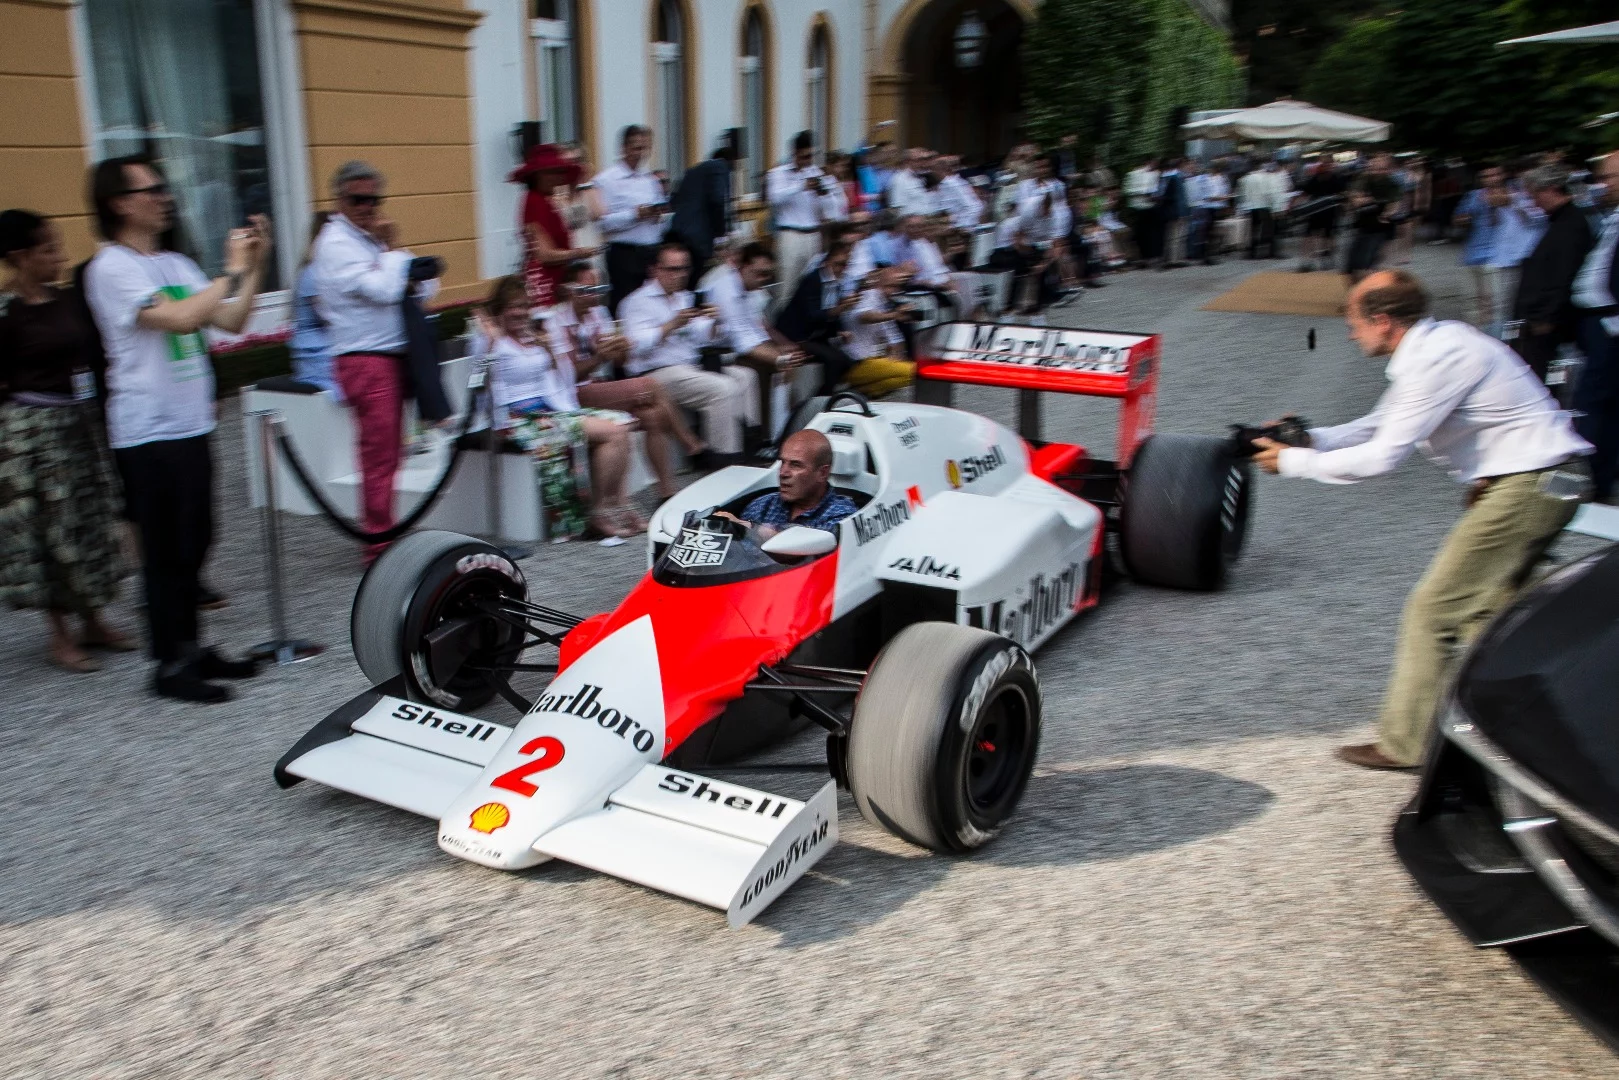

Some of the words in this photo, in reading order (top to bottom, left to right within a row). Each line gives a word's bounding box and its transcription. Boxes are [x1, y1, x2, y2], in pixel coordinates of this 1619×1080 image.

[960, 445, 1007, 483] Shell
[669, 547, 722, 566] HEUER
[681, 531, 722, 550] TAG
[391, 703, 497, 743] Shell
[490, 736, 566, 798] 2
[658, 773, 788, 819] Shell
